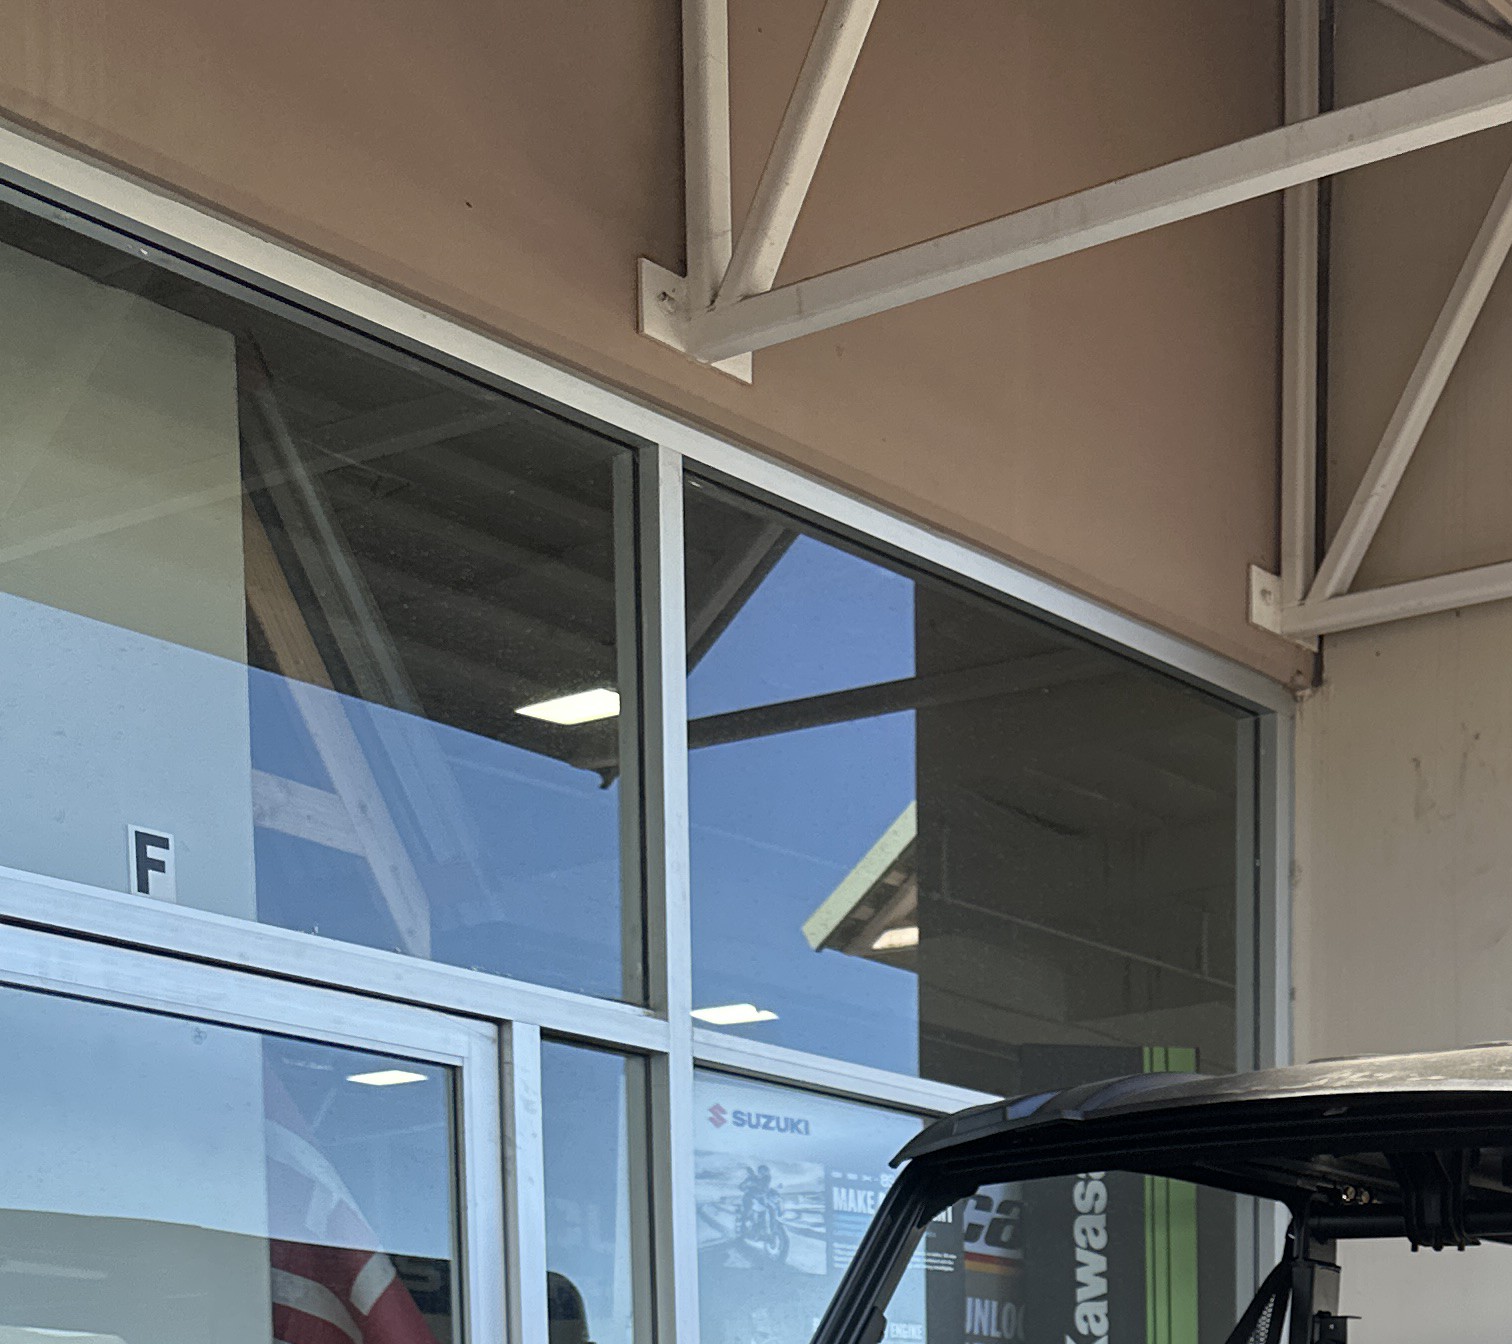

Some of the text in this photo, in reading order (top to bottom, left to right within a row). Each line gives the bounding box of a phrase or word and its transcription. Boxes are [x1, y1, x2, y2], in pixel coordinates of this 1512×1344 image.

[133, 829, 170, 895] F
[732, 1109, 810, 1136] SUZUKI
[832, 1186, 876, 1215] MAKE
